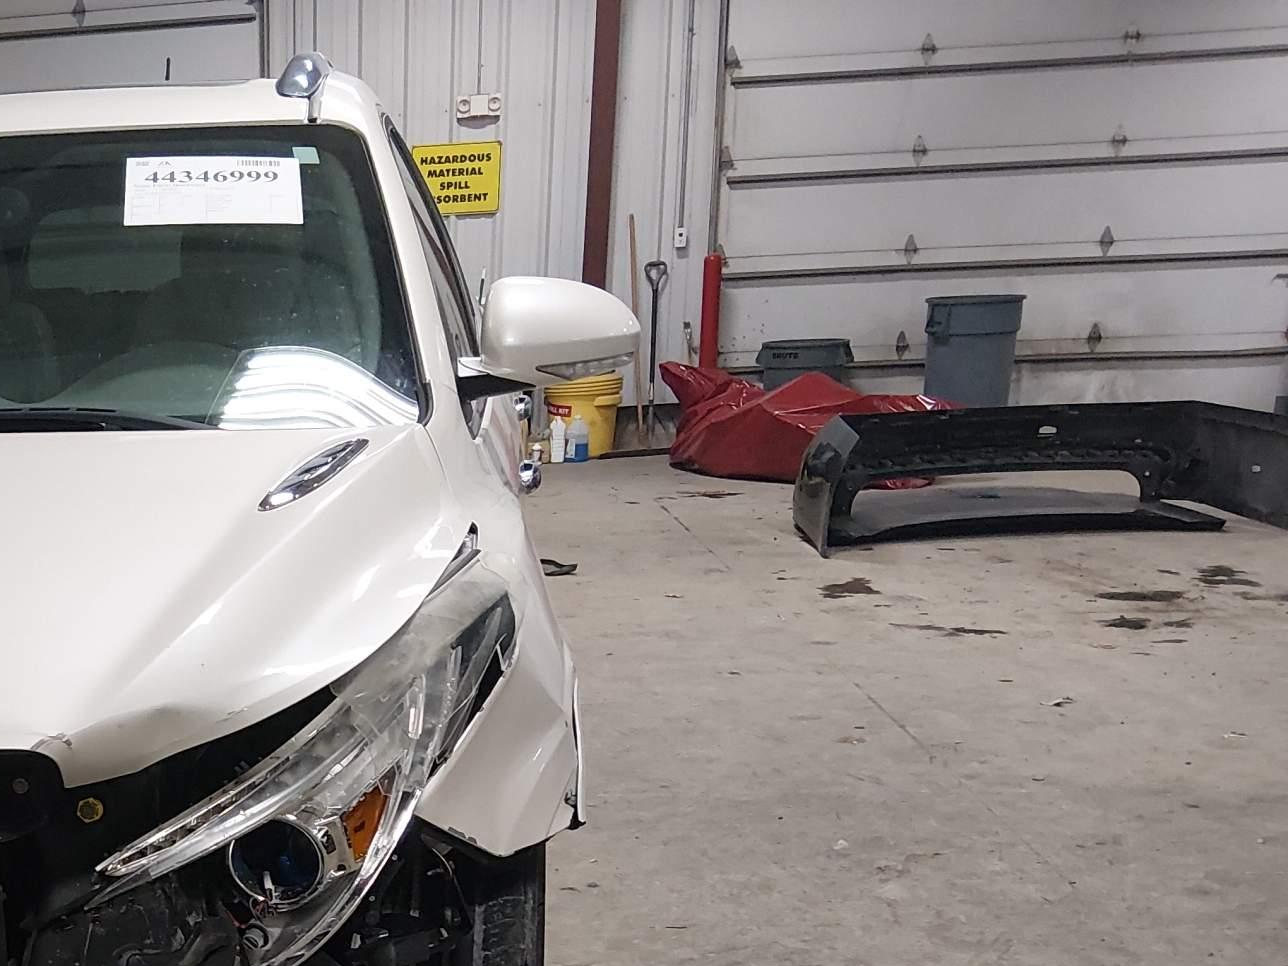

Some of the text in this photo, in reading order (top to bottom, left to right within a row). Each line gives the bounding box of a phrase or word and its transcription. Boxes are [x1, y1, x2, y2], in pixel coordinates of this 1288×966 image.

[420, 153, 492, 166] HAZARDOUS
[144, 170, 279, 184] 44346999
[427, 167, 484, 178] MATERIAL
[439, 181, 470, 191] SPILL
[434, 192, 489, 205] SORBENT
